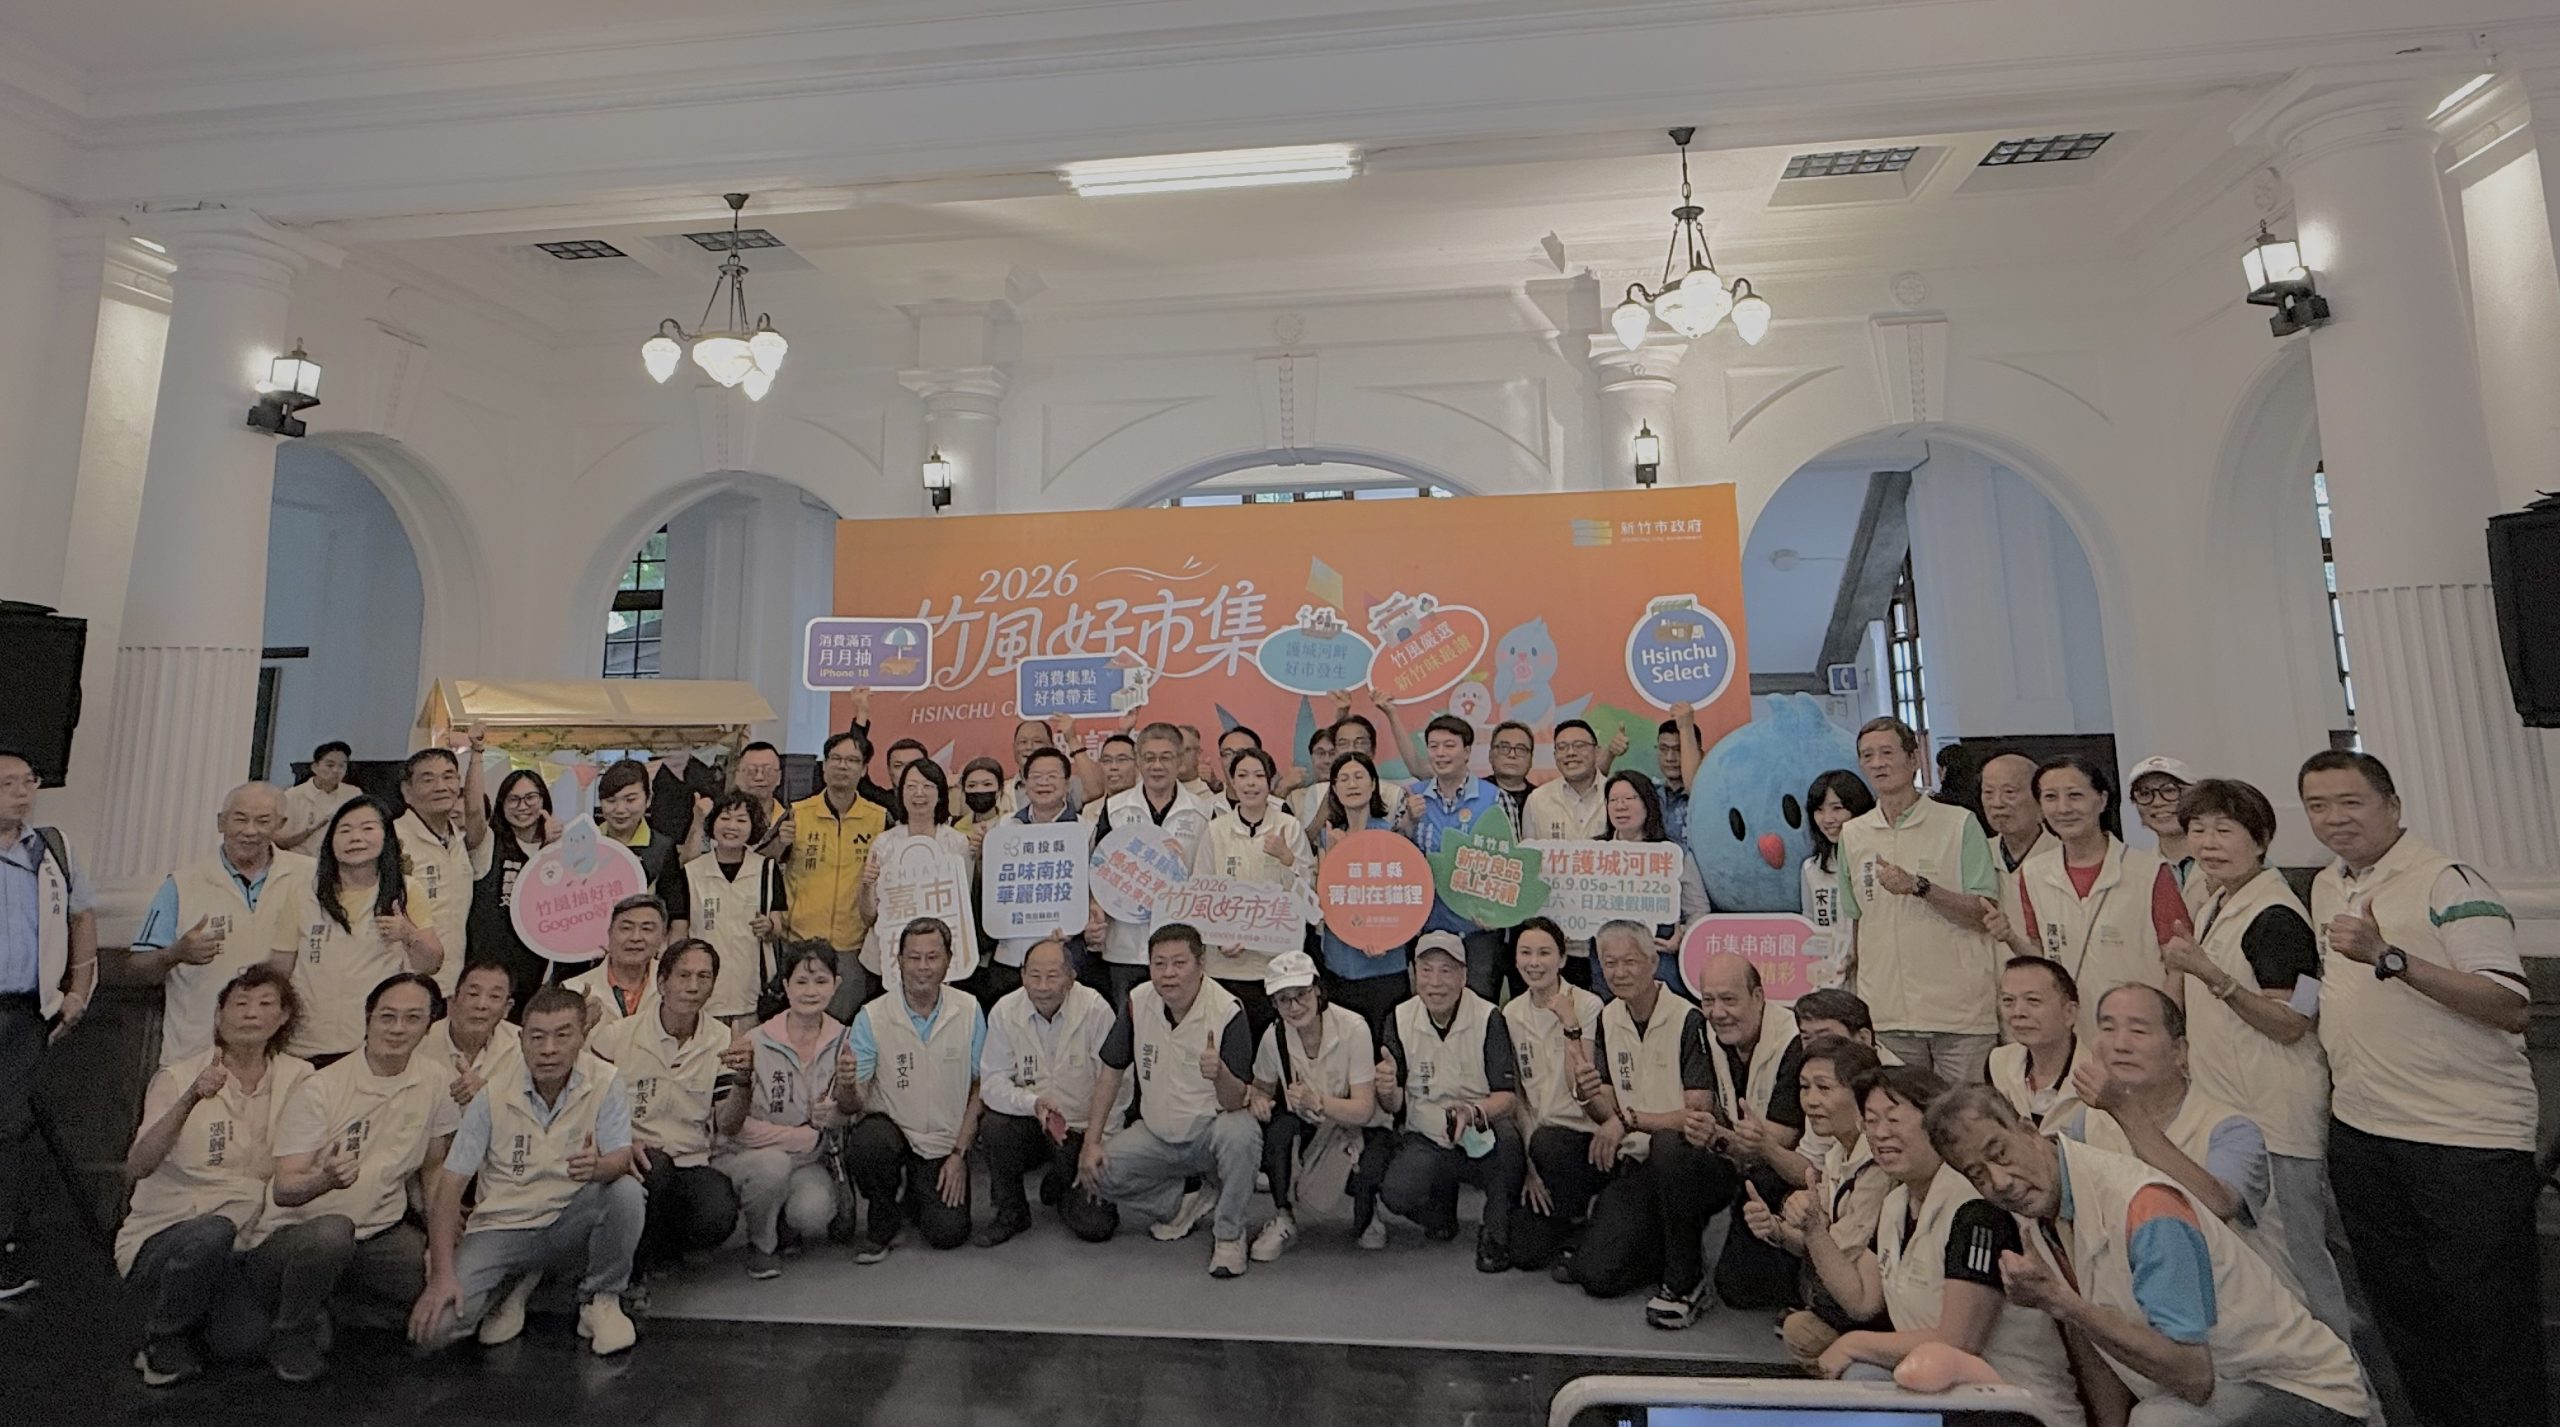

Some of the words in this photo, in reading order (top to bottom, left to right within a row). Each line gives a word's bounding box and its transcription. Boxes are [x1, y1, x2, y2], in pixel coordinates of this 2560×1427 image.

[1621, 519, 1703, 535] 新竹市政府
[974, 559, 1079, 604] 2026
[819, 633, 873, 648] 消費滿百
[912, 579, 1270, 692] 竹風好市集
[818, 648, 872, 667] 月月抽
[1286, 641, 1349, 661] 護城河畔
[1641, 642, 1718, 666] Hsinchu
[820, 668, 855, 678] iPhone
[858, 668, 870, 678] 18
[1034, 669, 1097, 687] 消費集點
[1651, 662, 1712, 684] Select
[1034, 689, 1097, 707] 好禮帶走
[910, 702, 996, 724] HSINCHU
[1022, 839, 1065, 855] 南投縣
[1473, 833, 1510, 854] 新竹縣
[998, 860, 1074, 882] 品味南投
[1347, 861, 1403, 878] 苗栗縣
[1456, 846, 1523, 882] 新竹良品
[1540, 848, 1674, 877] 竹護城河畔
[996, 882, 1073, 905] 華麗領投
[1189, 878, 1228, 893] 2026
[1450, 870, 1519, 906] 縣上好禮
[884, 877, 954, 920] 嘉市
[1158, 886, 1299, 933] 竹風好市集
[1705, 932, 1797, 957] 市集串商圈
